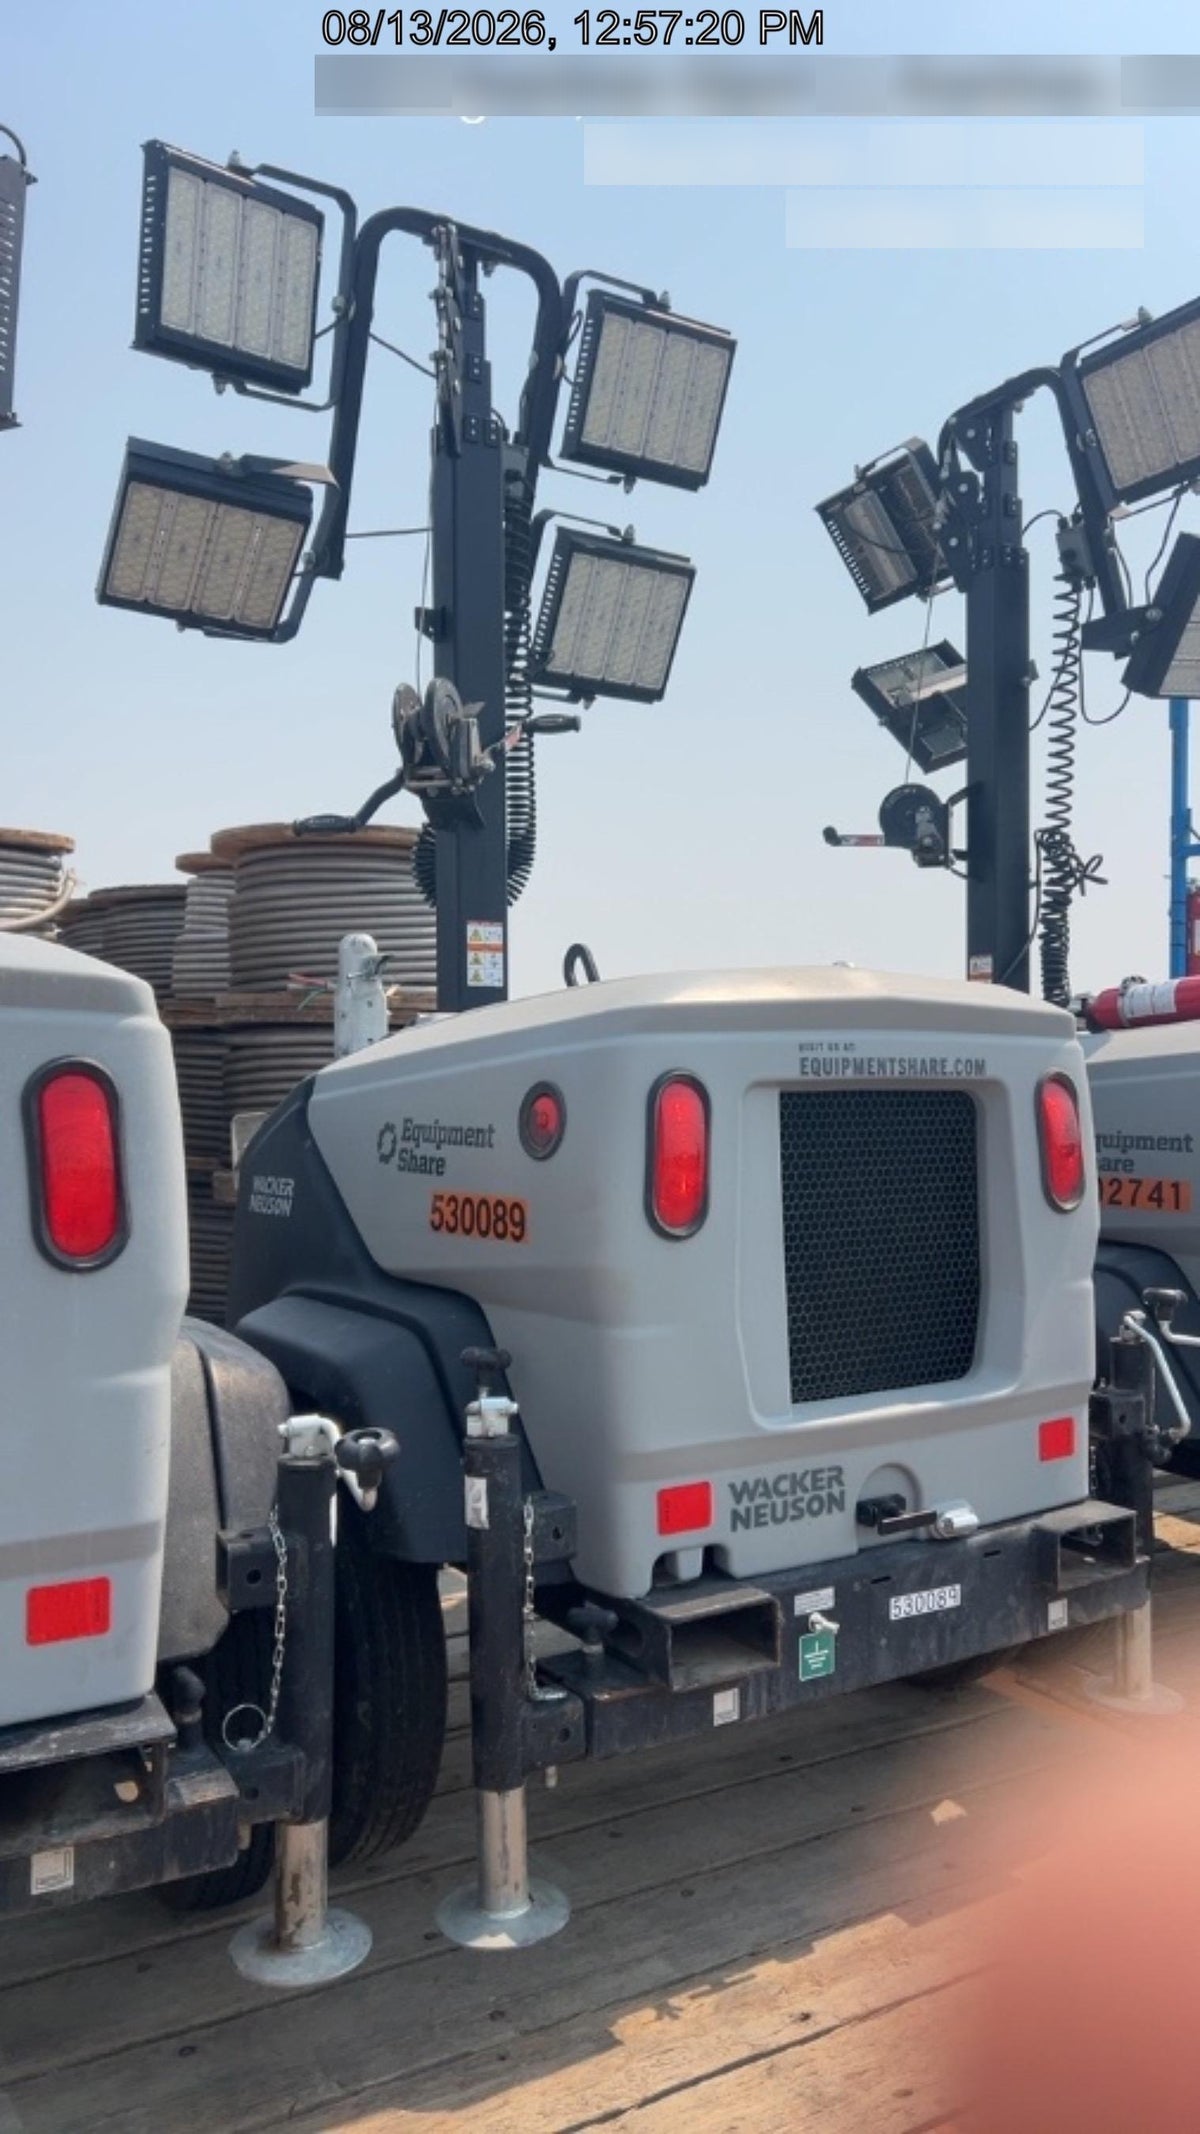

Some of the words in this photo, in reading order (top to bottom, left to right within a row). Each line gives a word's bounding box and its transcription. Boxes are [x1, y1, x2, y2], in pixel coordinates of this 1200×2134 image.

[799, 1056, 987, 1078] EQUIPMENTSHARE.COM
[401, 1117, 496, 1150] Equipment
[397, 1147, 447, 1176] Share
[1099, 1156, 1135, 1173] are
[253, 1176, 295, 1197] WACKER
[248, 1194, 293, 1217] NEUSON
[430, 1194, 526, 1242] 530089
[727, 1465, 845, 1505] WACKER
[730, 1489, 845, 1533] NEUSON
[891, 1586, 961, 1618] 530089
